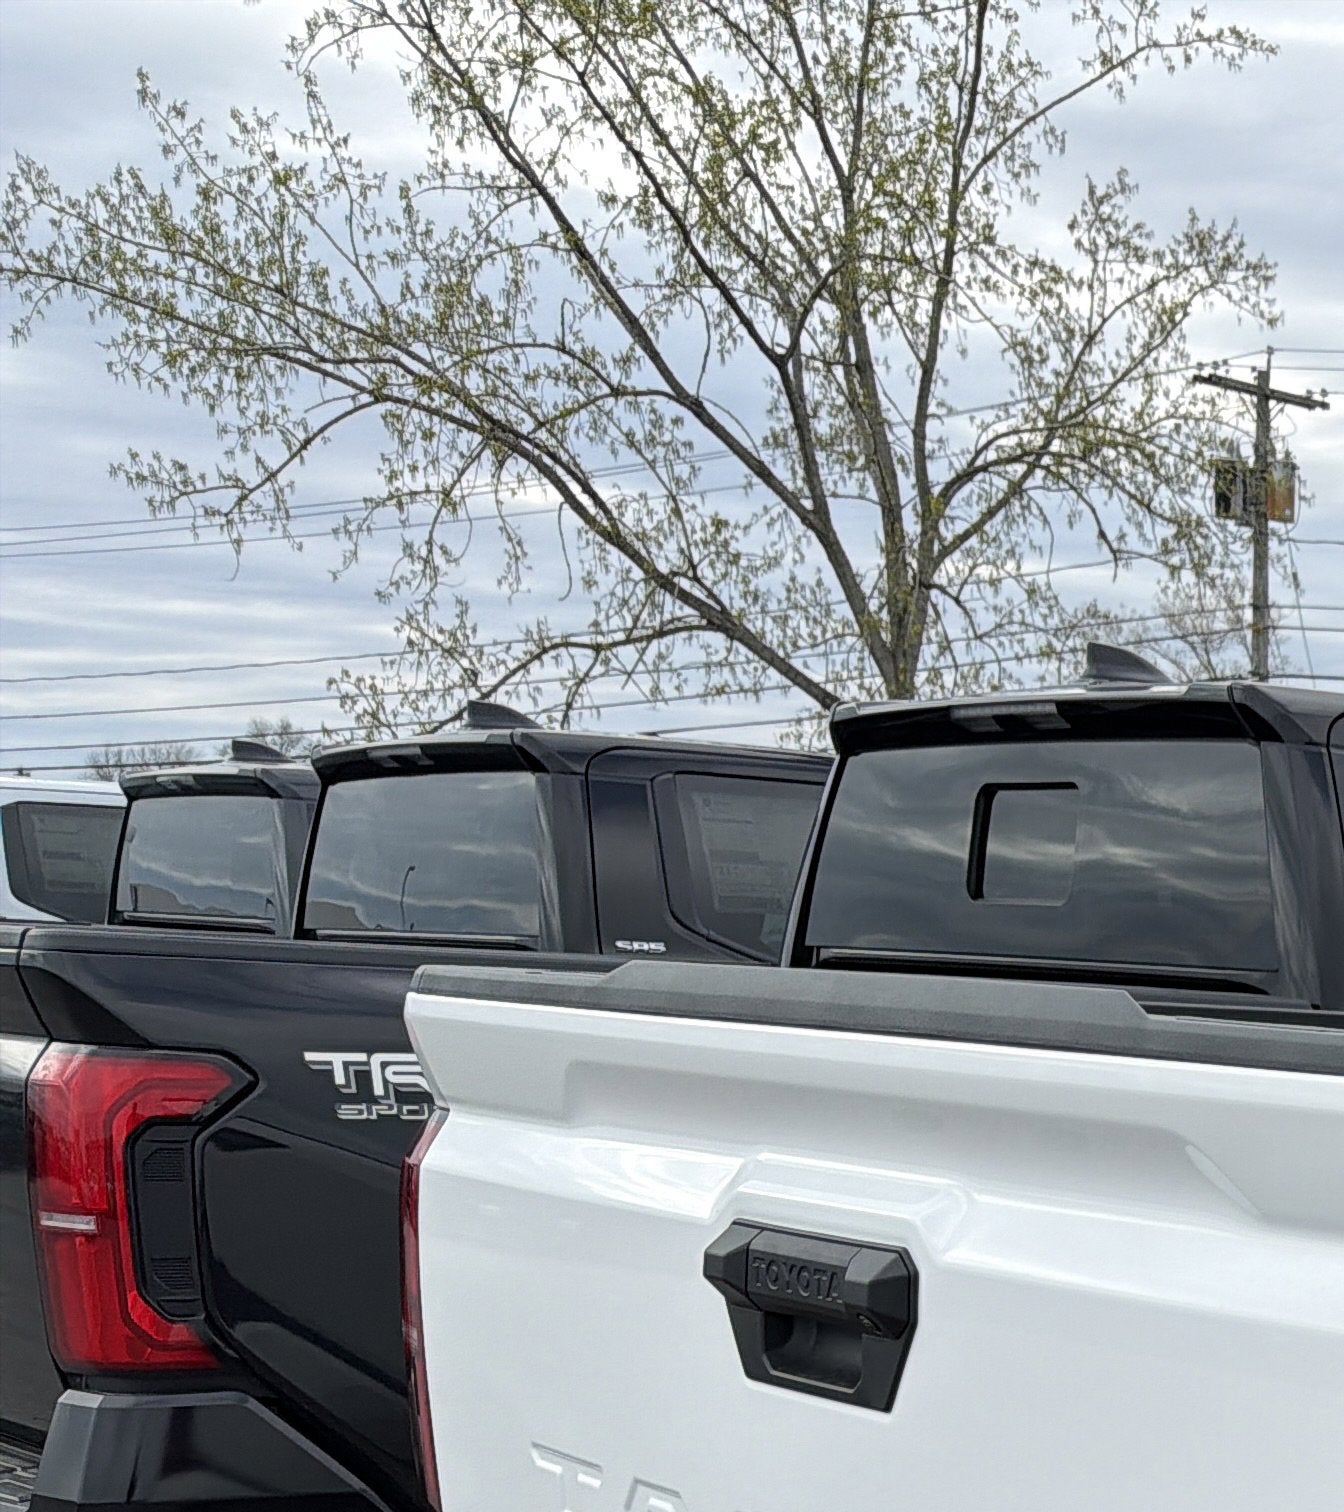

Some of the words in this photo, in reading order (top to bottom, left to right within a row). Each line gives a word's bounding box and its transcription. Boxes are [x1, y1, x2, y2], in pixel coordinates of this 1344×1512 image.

[303, 1051, 433, 1104] TR
[335, 1102, 437, 1120] SPO
[751, 1256, 844, 1304] TOYOTA
